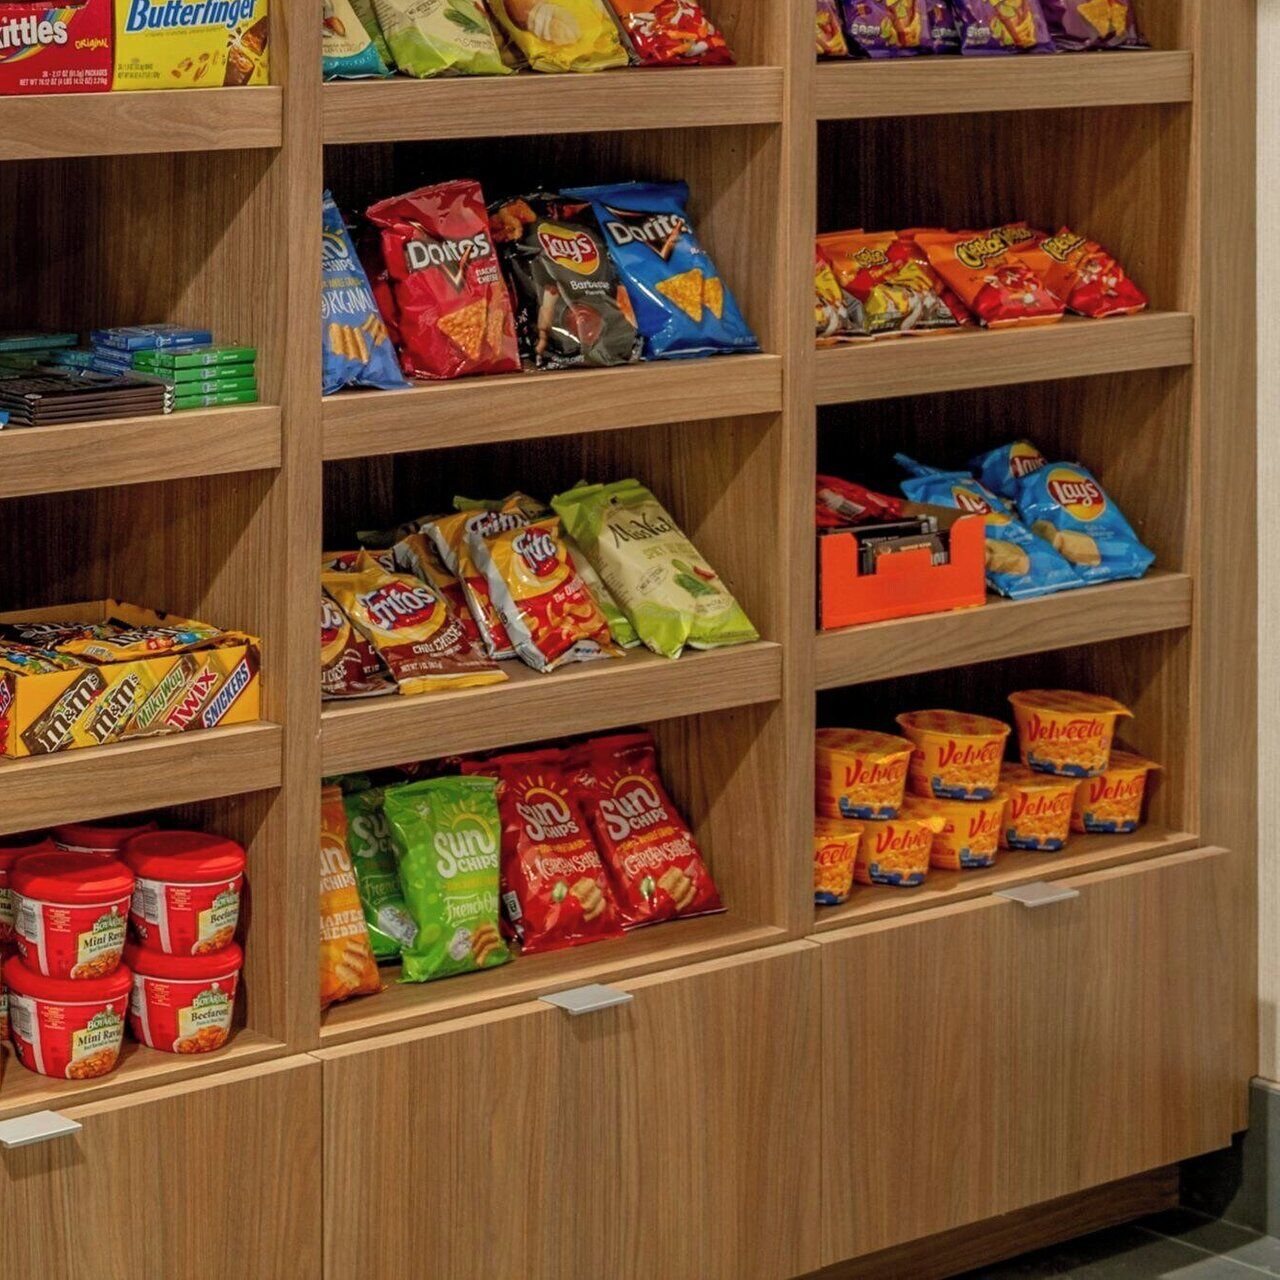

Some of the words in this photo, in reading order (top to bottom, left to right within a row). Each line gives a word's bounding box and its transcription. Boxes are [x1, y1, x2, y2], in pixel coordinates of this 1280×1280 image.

[408, 234, 490, 269] Doritos
[545, 233, 591, 262] Lay's
[1056, 480, 1100, 506] Lay's
[362, 584, 437, 630] Fritos
[165, 667, 218, 731] TWIX
[203, 660, 251, 729] SNICKERS
[1027, 714, 1106, 743] Velveeta
[519, 800, 568, 841] Sun
[599, 787, 660, 841] Sun
[630, 808, 668, 829] CHIPS
[434, 830, 496, 878] Sun
[458, 853, 498, 877] CHIPS
[444, 898, 482, 921] French
[84, 936, 105, 949] Mini
[78, 1033, 100, 1046] Mini
